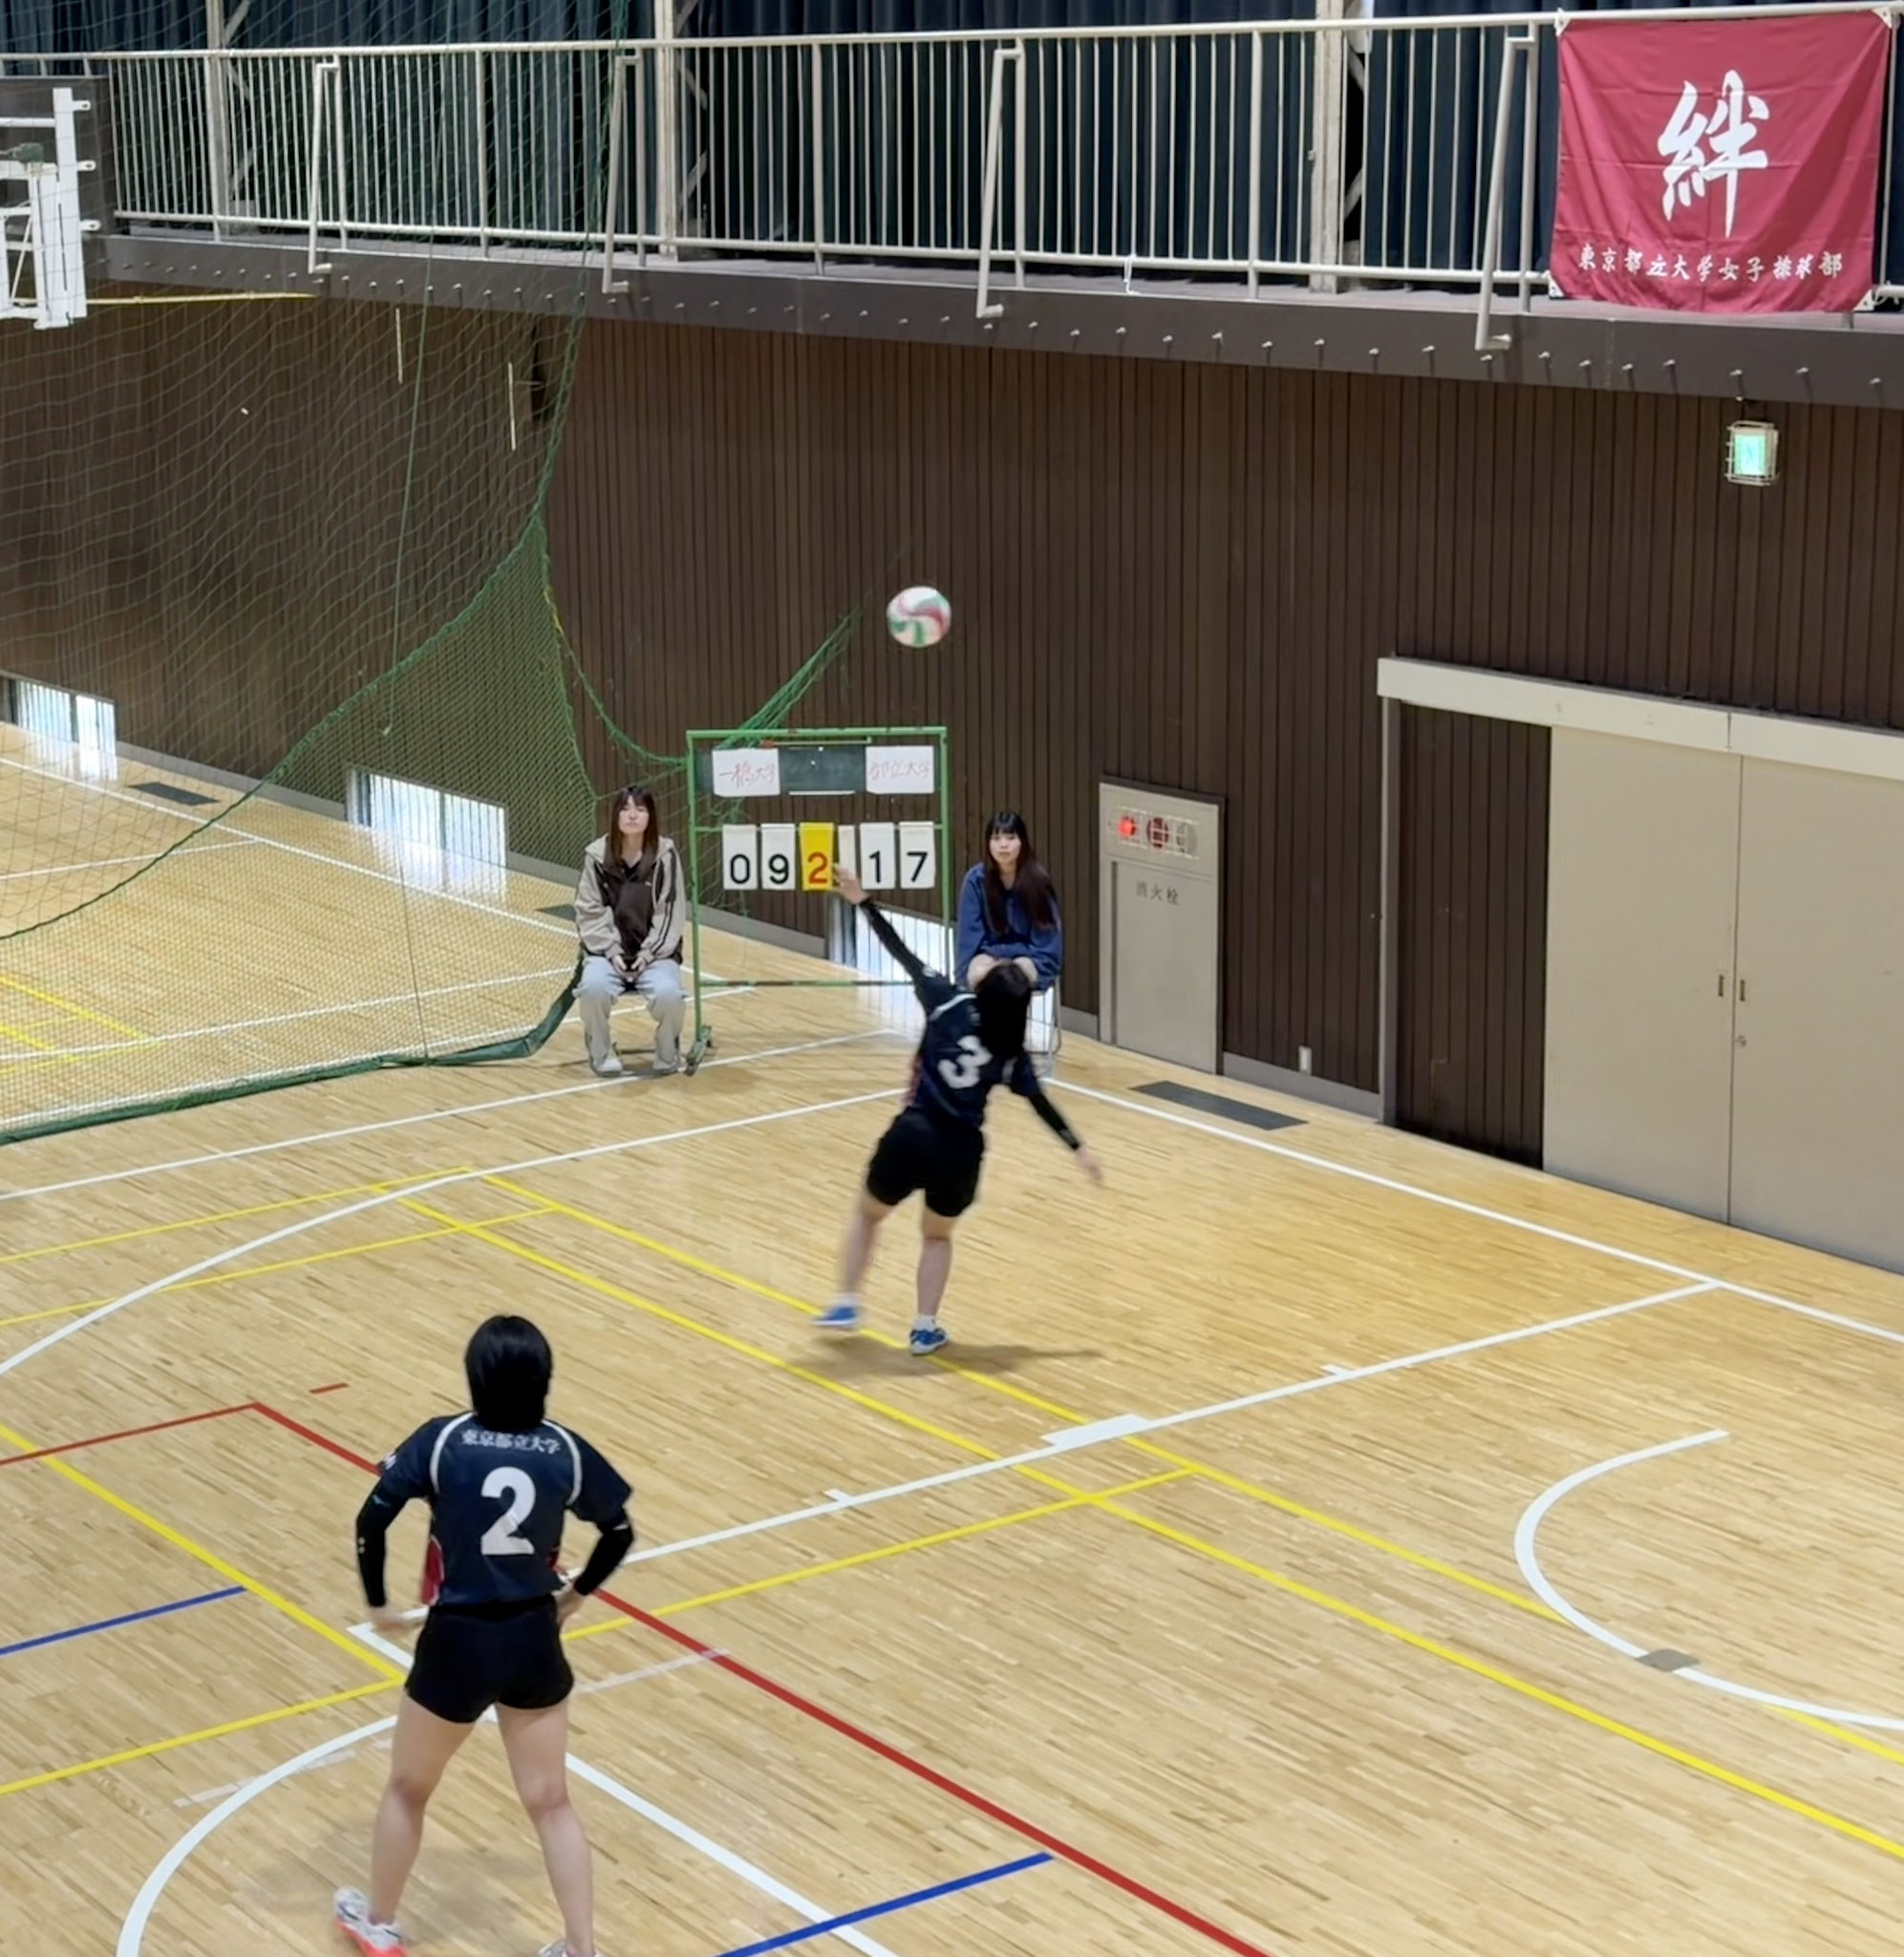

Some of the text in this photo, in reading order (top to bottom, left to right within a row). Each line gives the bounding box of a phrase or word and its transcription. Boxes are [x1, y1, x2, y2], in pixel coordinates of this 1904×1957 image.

[1657, 69, 1770, 238] 絆
[807, 851, 829, 884] 2
[937, 1035, 994, 1089] 3
[481, 1466, 536, 1556] 2
